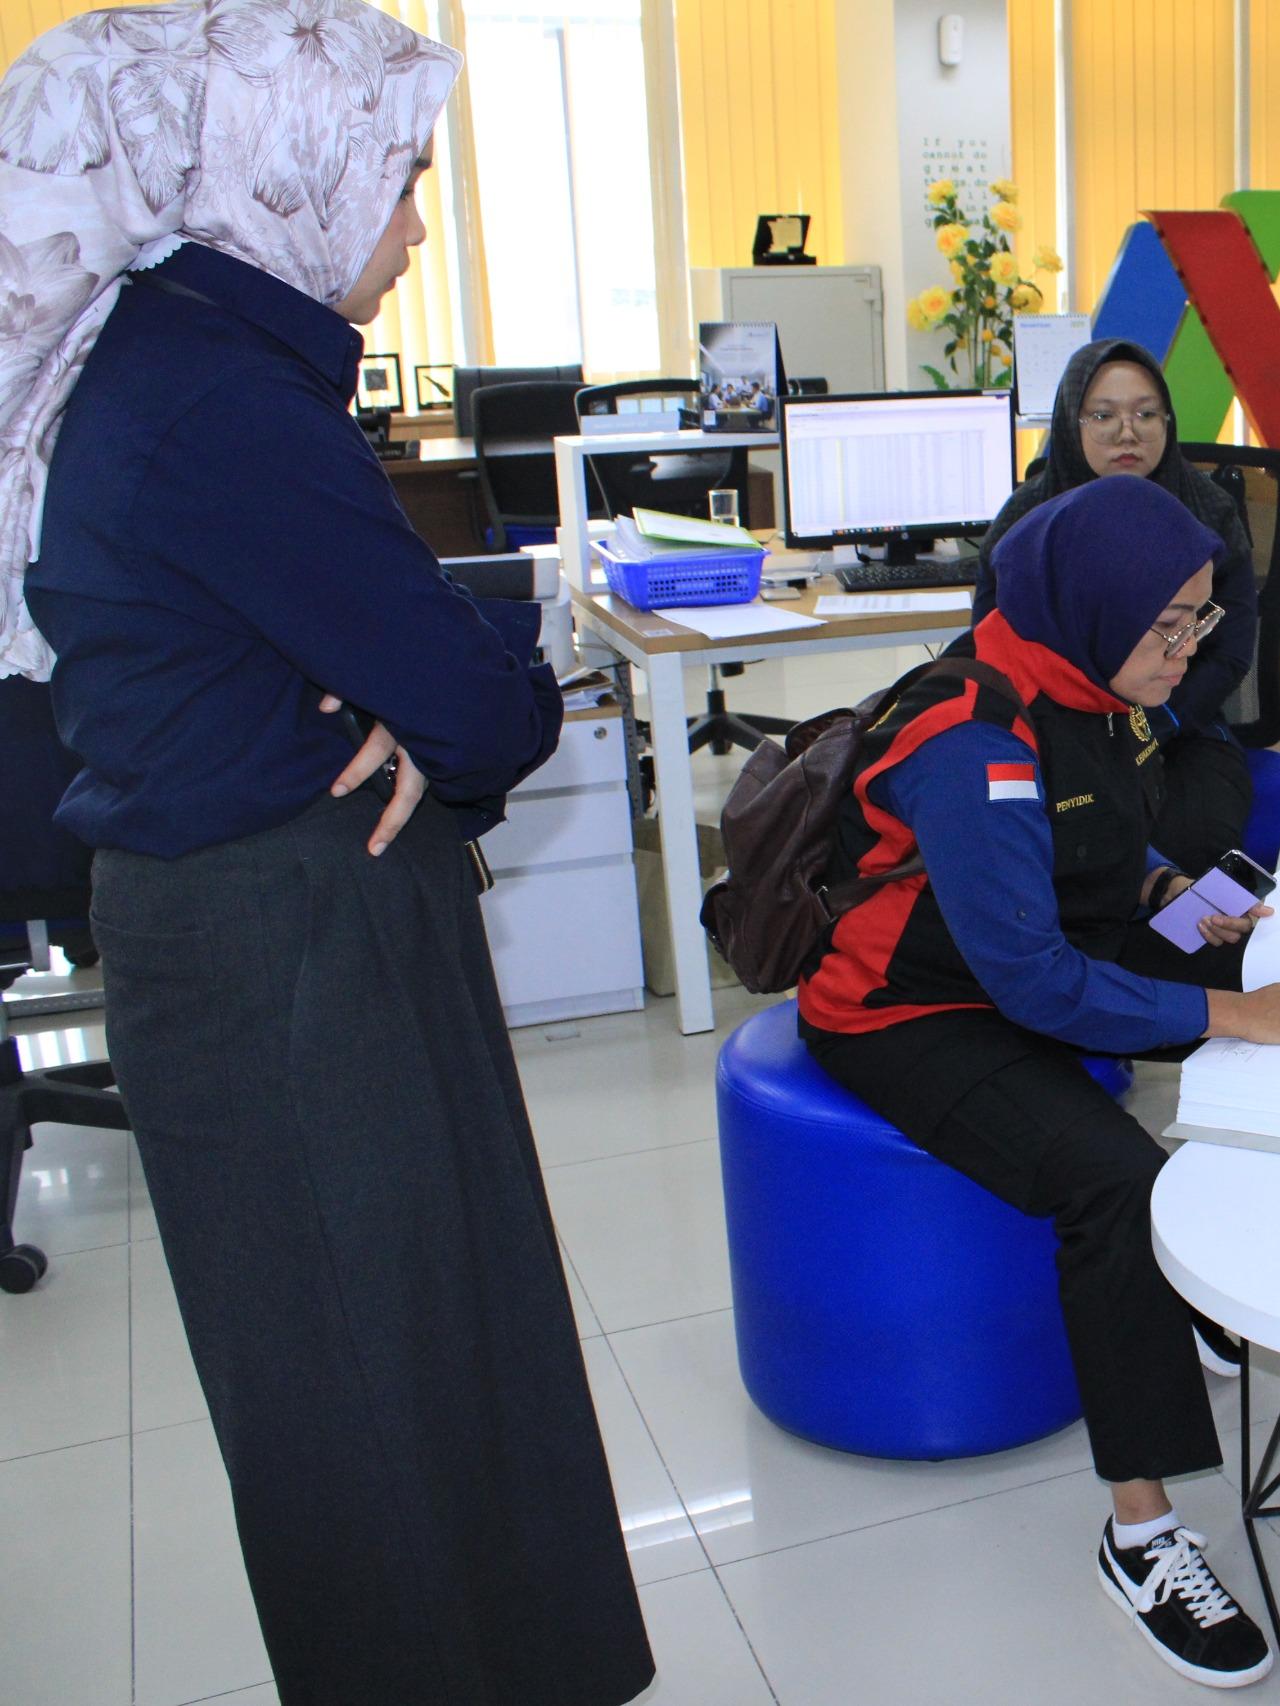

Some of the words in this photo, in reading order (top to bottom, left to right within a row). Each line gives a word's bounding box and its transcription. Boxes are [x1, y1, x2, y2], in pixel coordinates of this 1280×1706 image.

[922, 151, 964, 159] cannot
[973, 150, 988, 159] do
[1056, 793, 1095, 813] PENYIDIK
